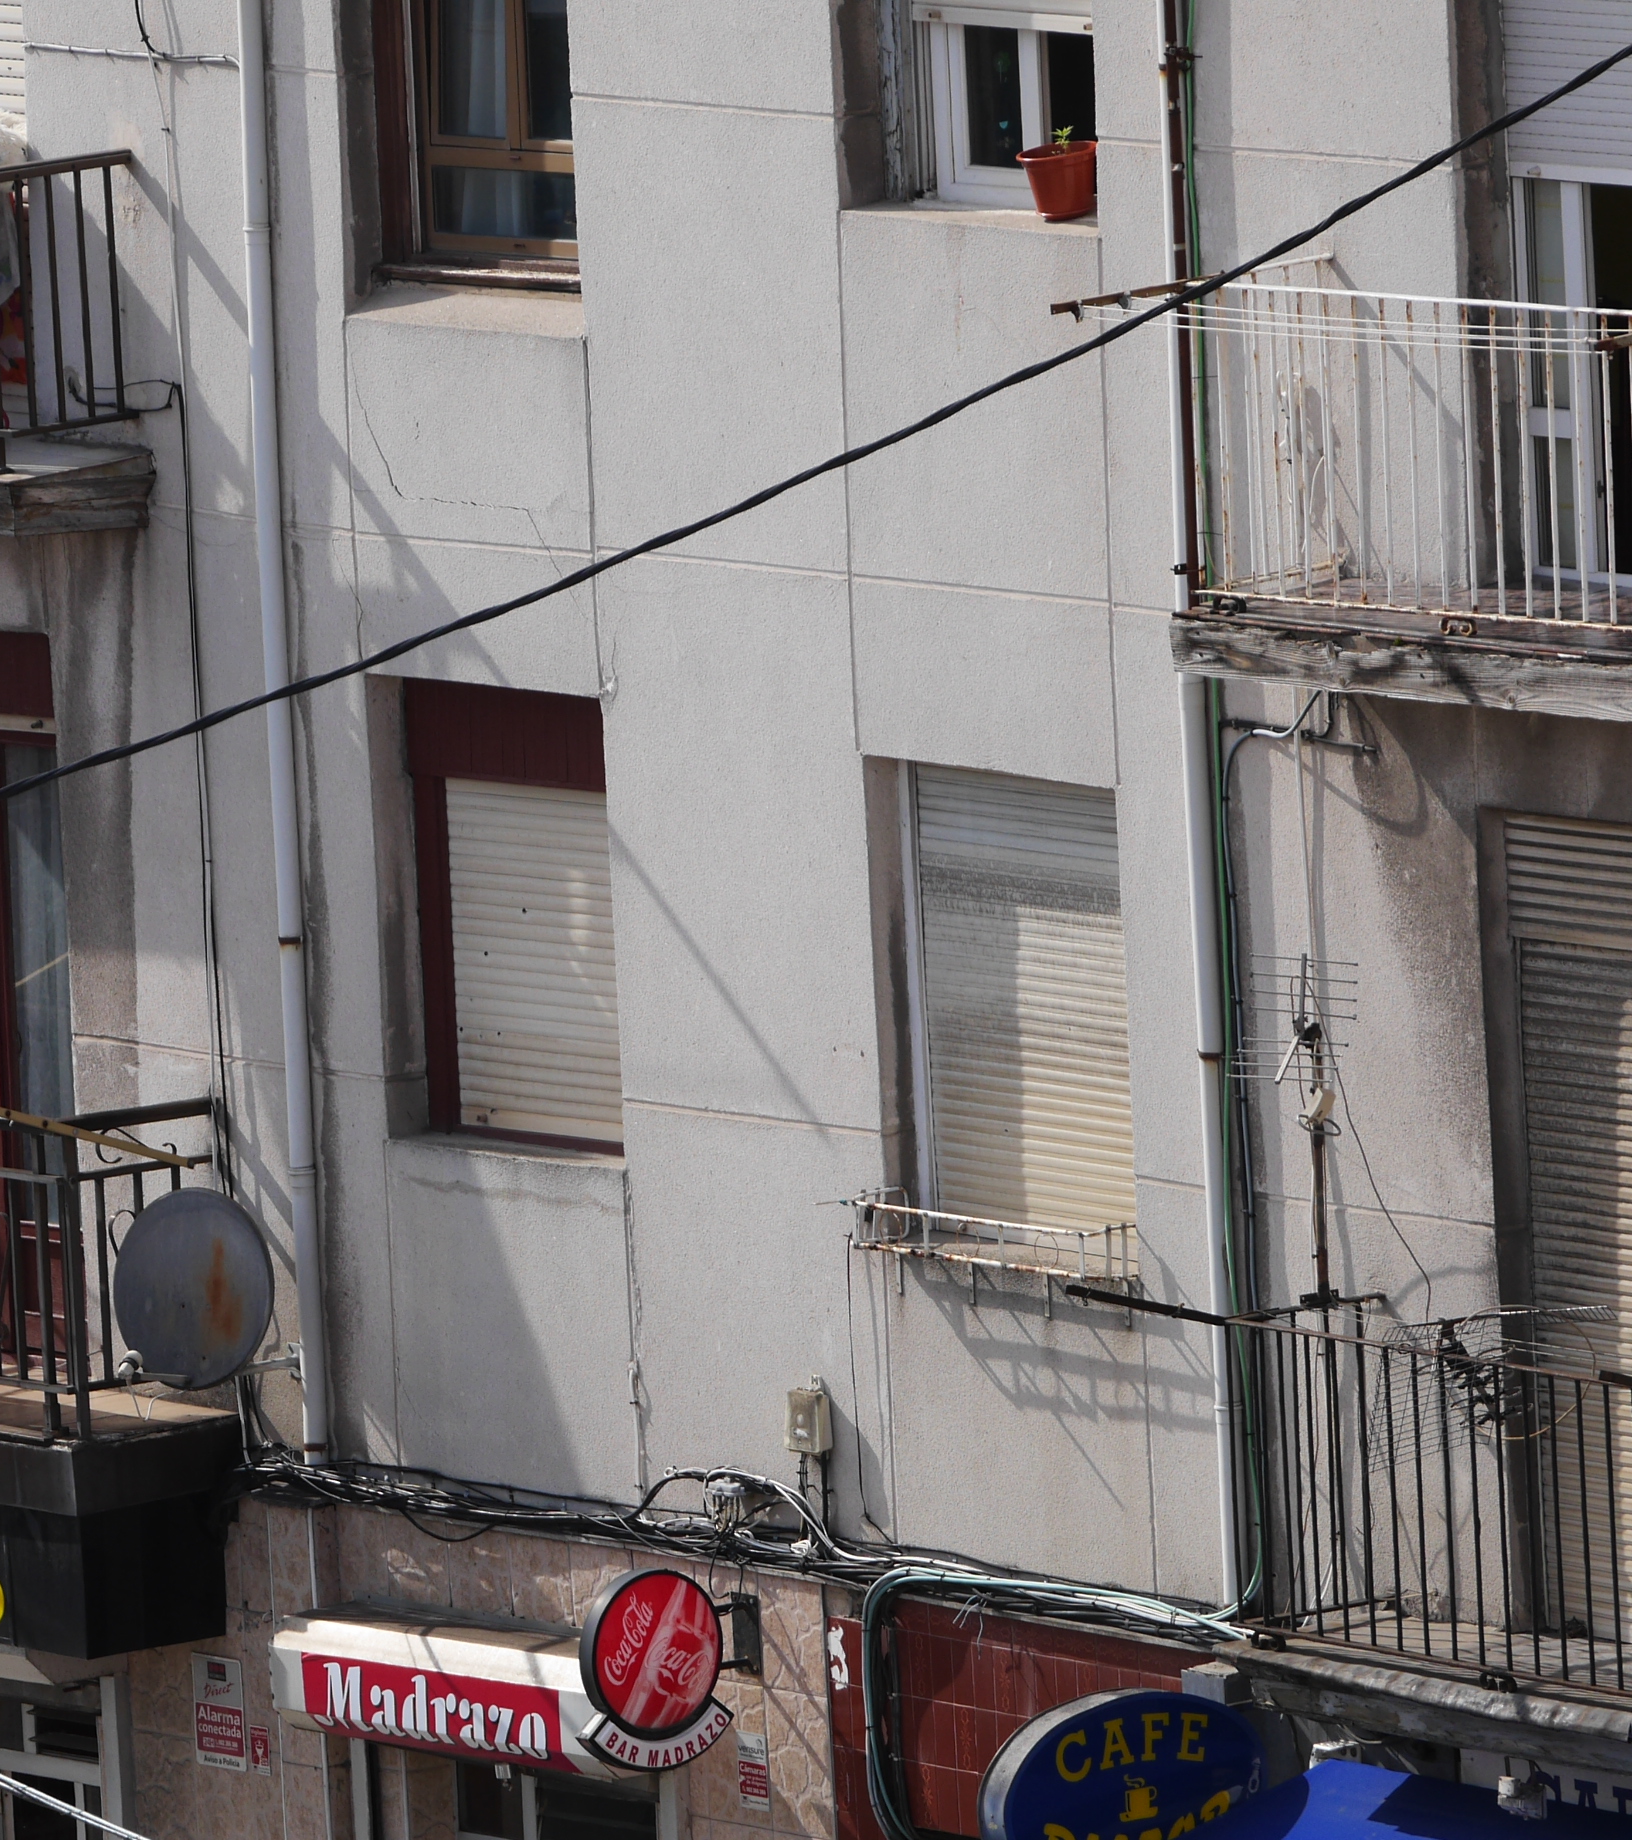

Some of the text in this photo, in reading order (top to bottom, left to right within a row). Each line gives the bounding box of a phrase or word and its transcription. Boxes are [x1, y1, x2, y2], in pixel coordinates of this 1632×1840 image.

[604, 1590, 654, 1686] Coca-Cola
[203, 1682, 235, 1699] Direct
[197, 1705, 241, 1726] Alarma
[314, 1661, 549, 1760] Madrazo
[197, 1722, 242, 1739] conectada
[605, 1712, 727, 1767] BAR MADRAZO
[737, 1745, 765, 1756] verisure
[1055, 1711, 1209, 1783] CAFE
[203, 1754, 218, 1763] Aviso
